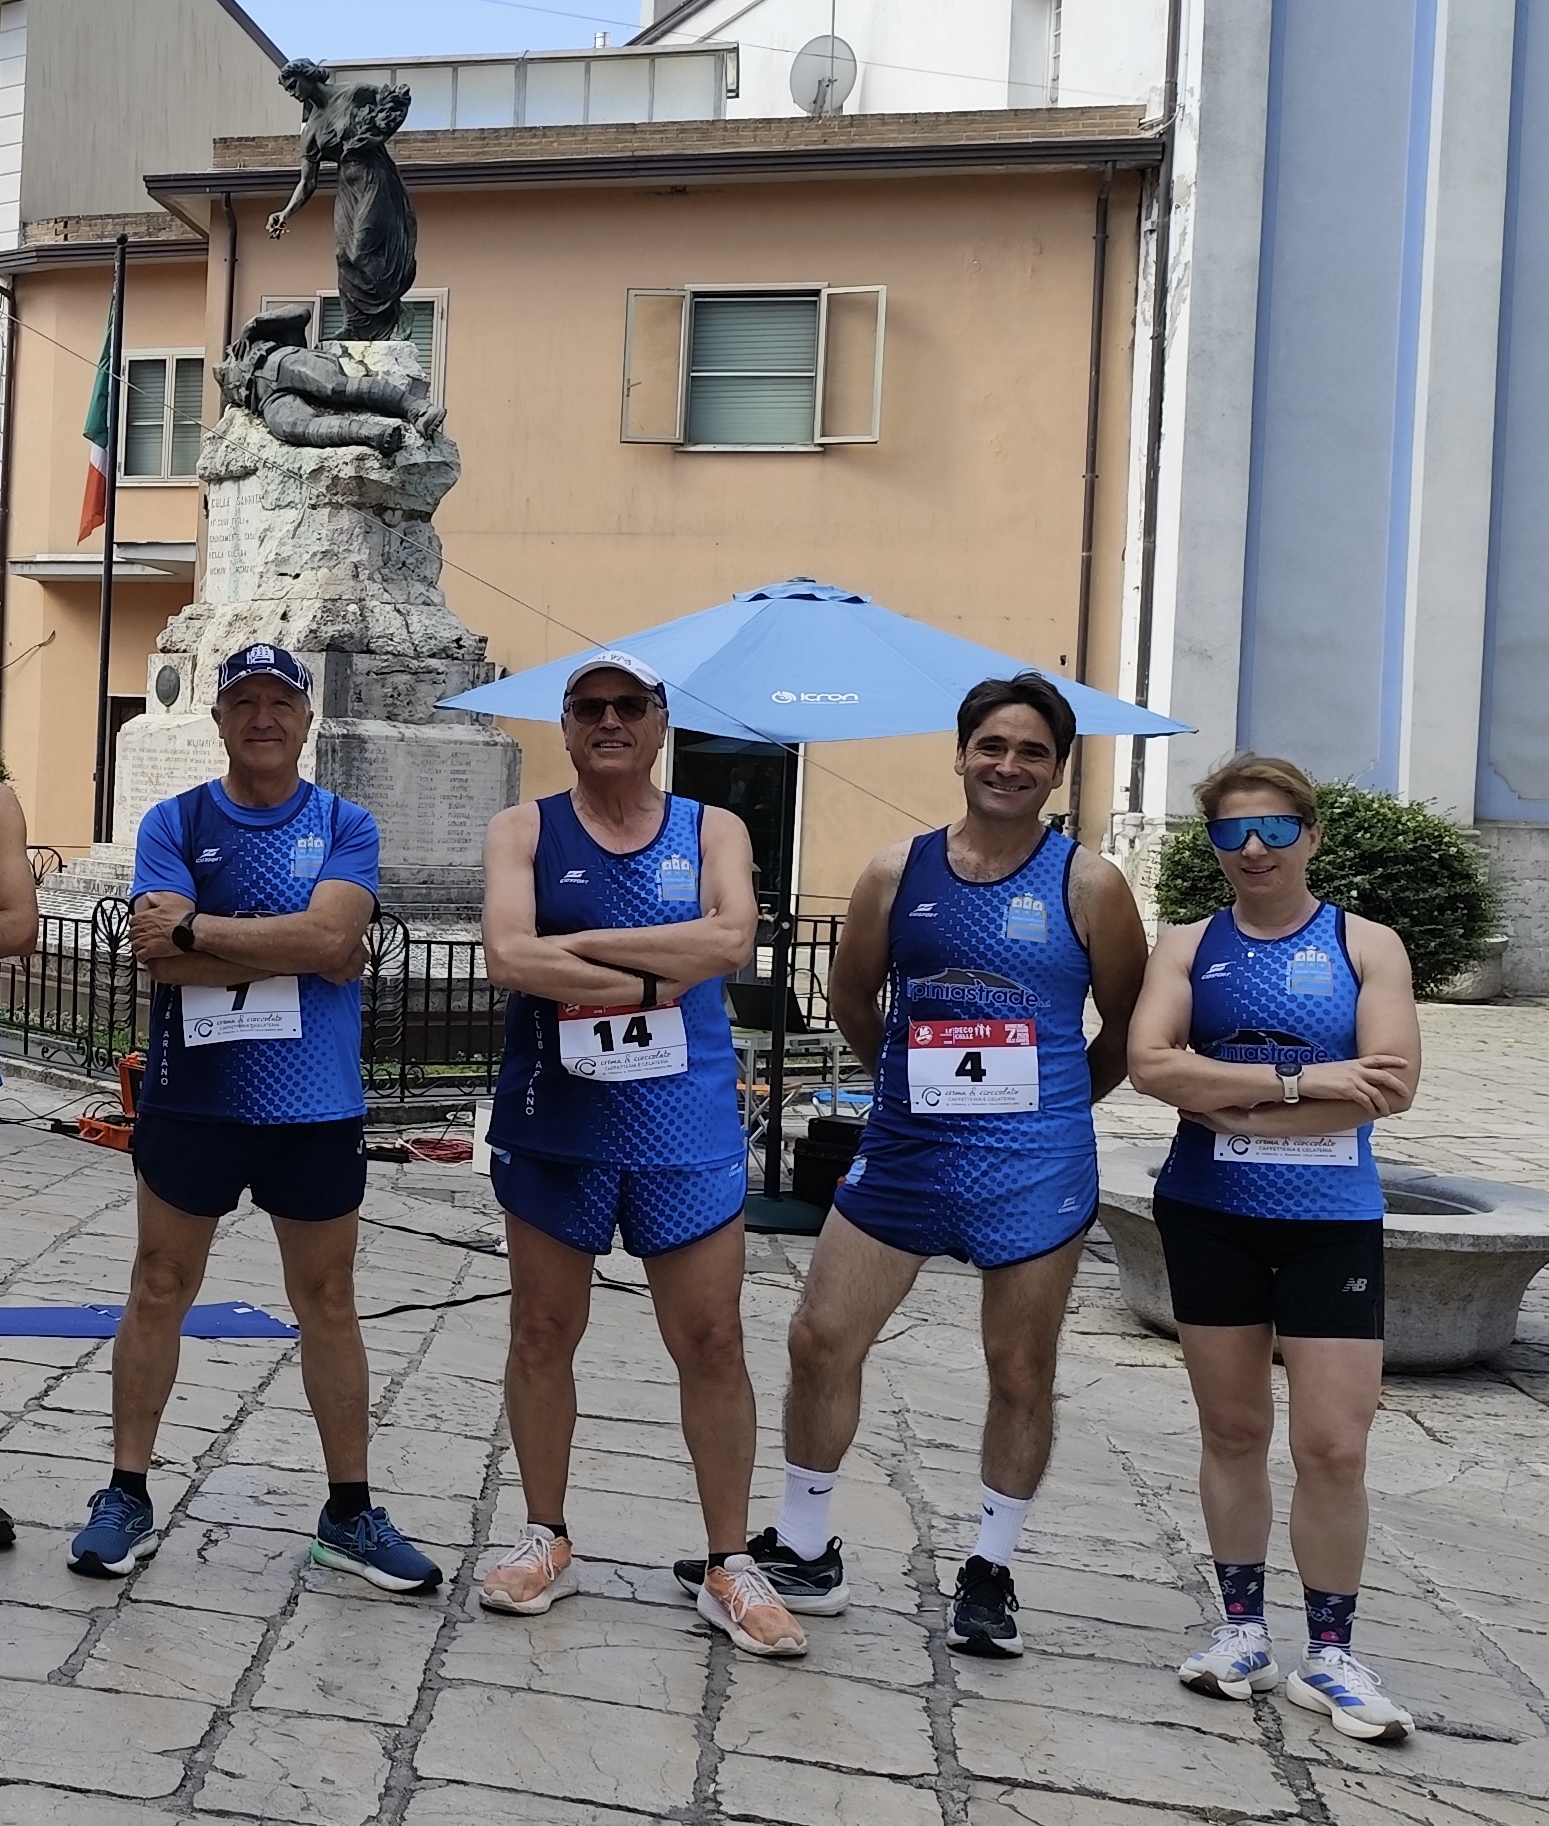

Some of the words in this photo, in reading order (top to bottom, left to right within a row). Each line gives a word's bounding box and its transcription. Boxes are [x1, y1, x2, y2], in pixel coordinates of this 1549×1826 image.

[533, 1010, 544, 1050] CLUB
[592, 1015, 653, 1053] 14
[953, 1026, 974, 1035] DECO
[160, 1030, 170, 1086] ARIANO
[954, 1051, 987, 1083] 4
[525, 1060, 543, 1116] ARIANO
